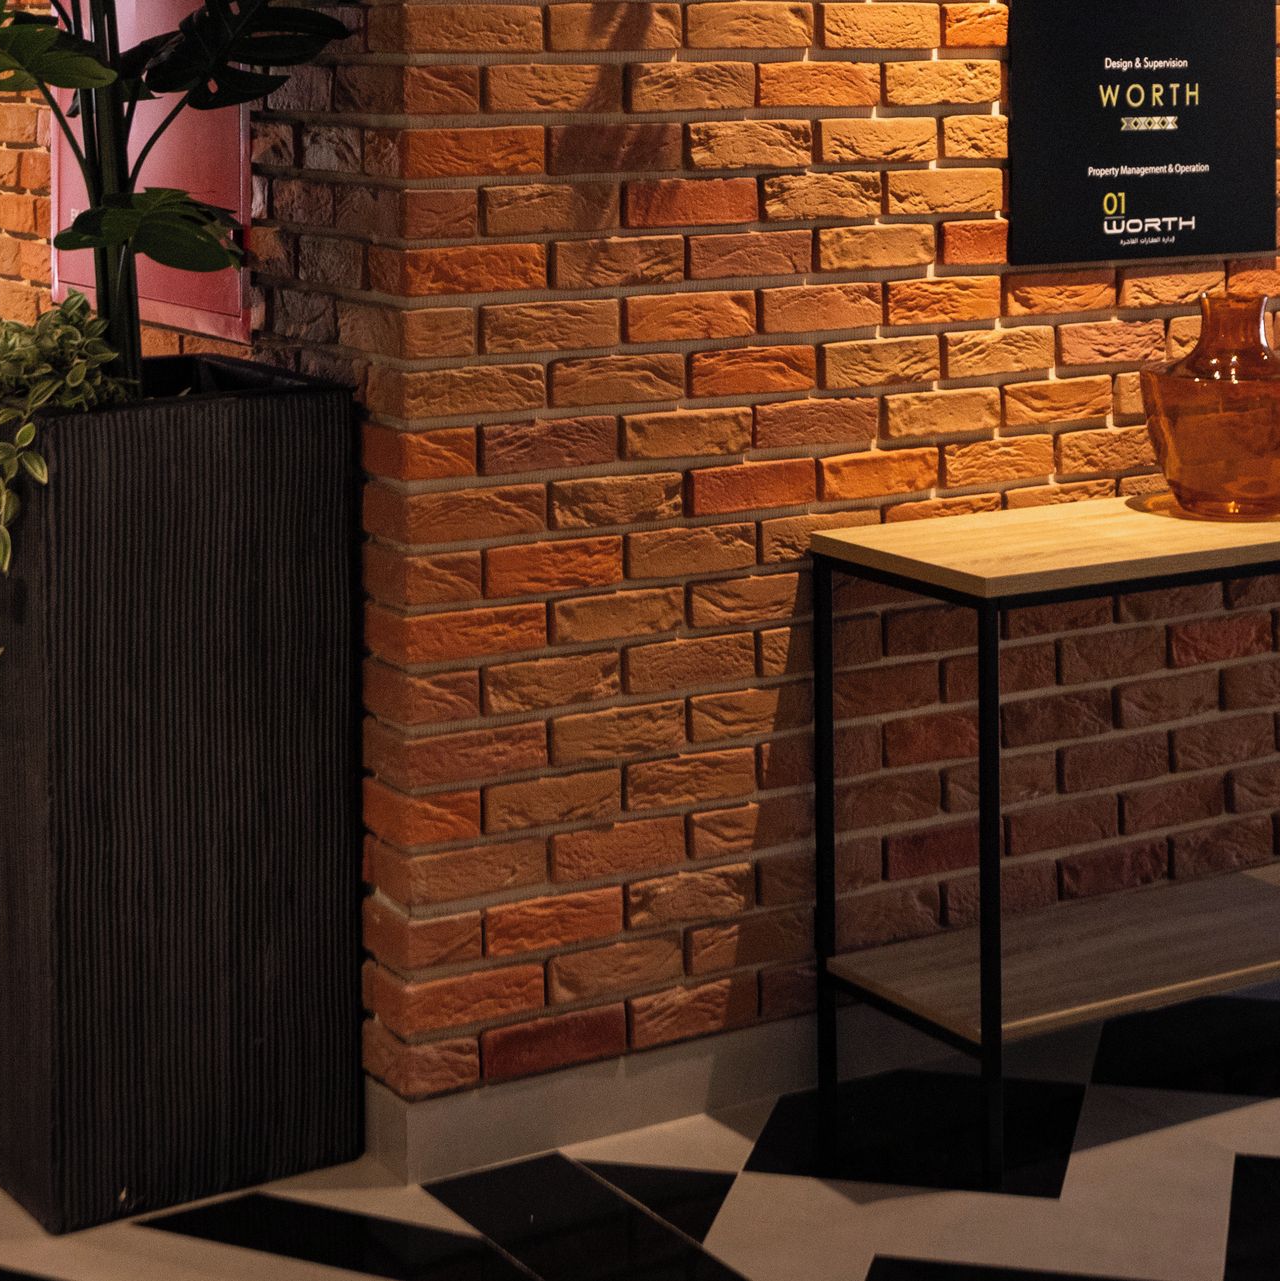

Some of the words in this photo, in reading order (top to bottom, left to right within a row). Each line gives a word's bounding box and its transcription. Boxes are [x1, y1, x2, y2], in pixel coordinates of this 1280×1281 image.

[1104, 56, 1133, 71] Design
[1134, 57, 1142, 69] &
[1143, 56, 1189, 71] Supervision
[1098, 82, 1200, 108] WORTH
[1087, 166, 1119, 178] Property
[1120, 164, 1167, 177] Management
[1167, 164, 1174, 174] &
[1174, 162, 1210, 175] Operation
[1102, 191, 1126, 216] 01
[1103, 216, 1196, 235] WORTH
